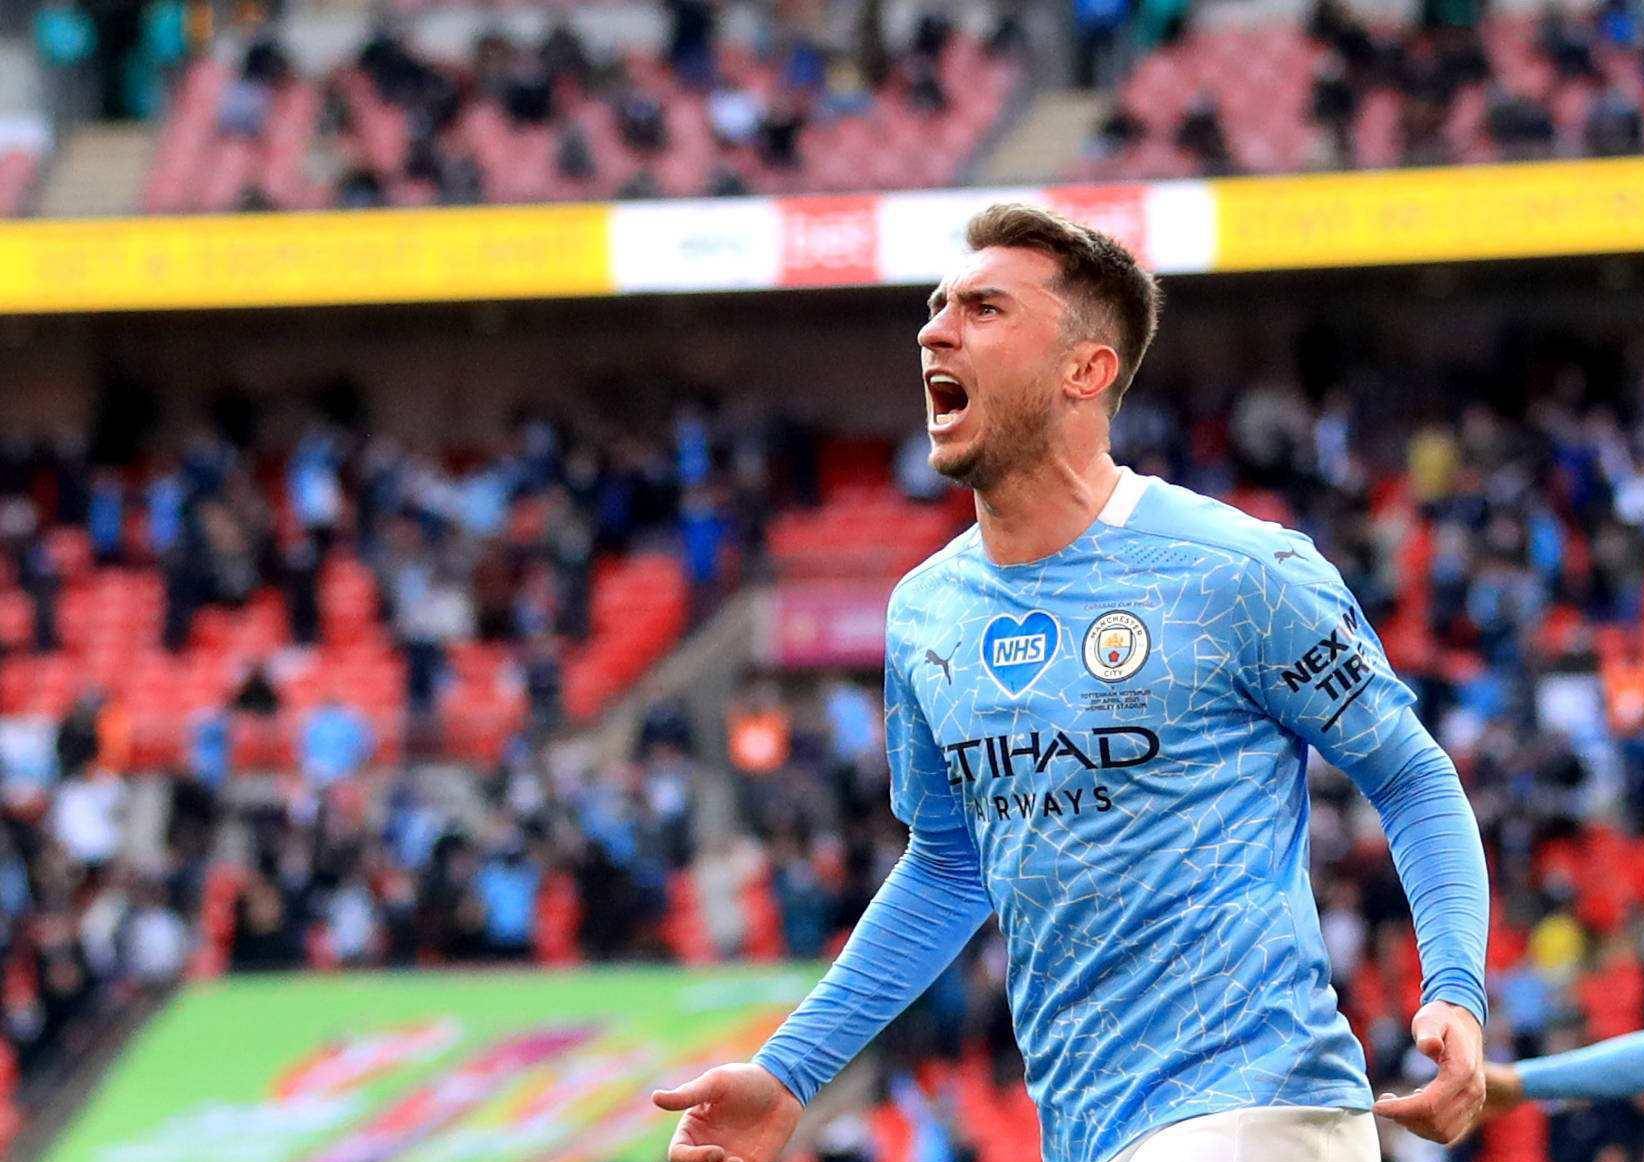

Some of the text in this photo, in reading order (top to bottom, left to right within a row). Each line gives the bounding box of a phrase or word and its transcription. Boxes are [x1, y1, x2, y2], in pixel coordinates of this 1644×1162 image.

[995, 637, 1043, 664] NHS
[1281, 605, 1358, 693] NEXN
[1314, 642, 1370, 701] TIR
